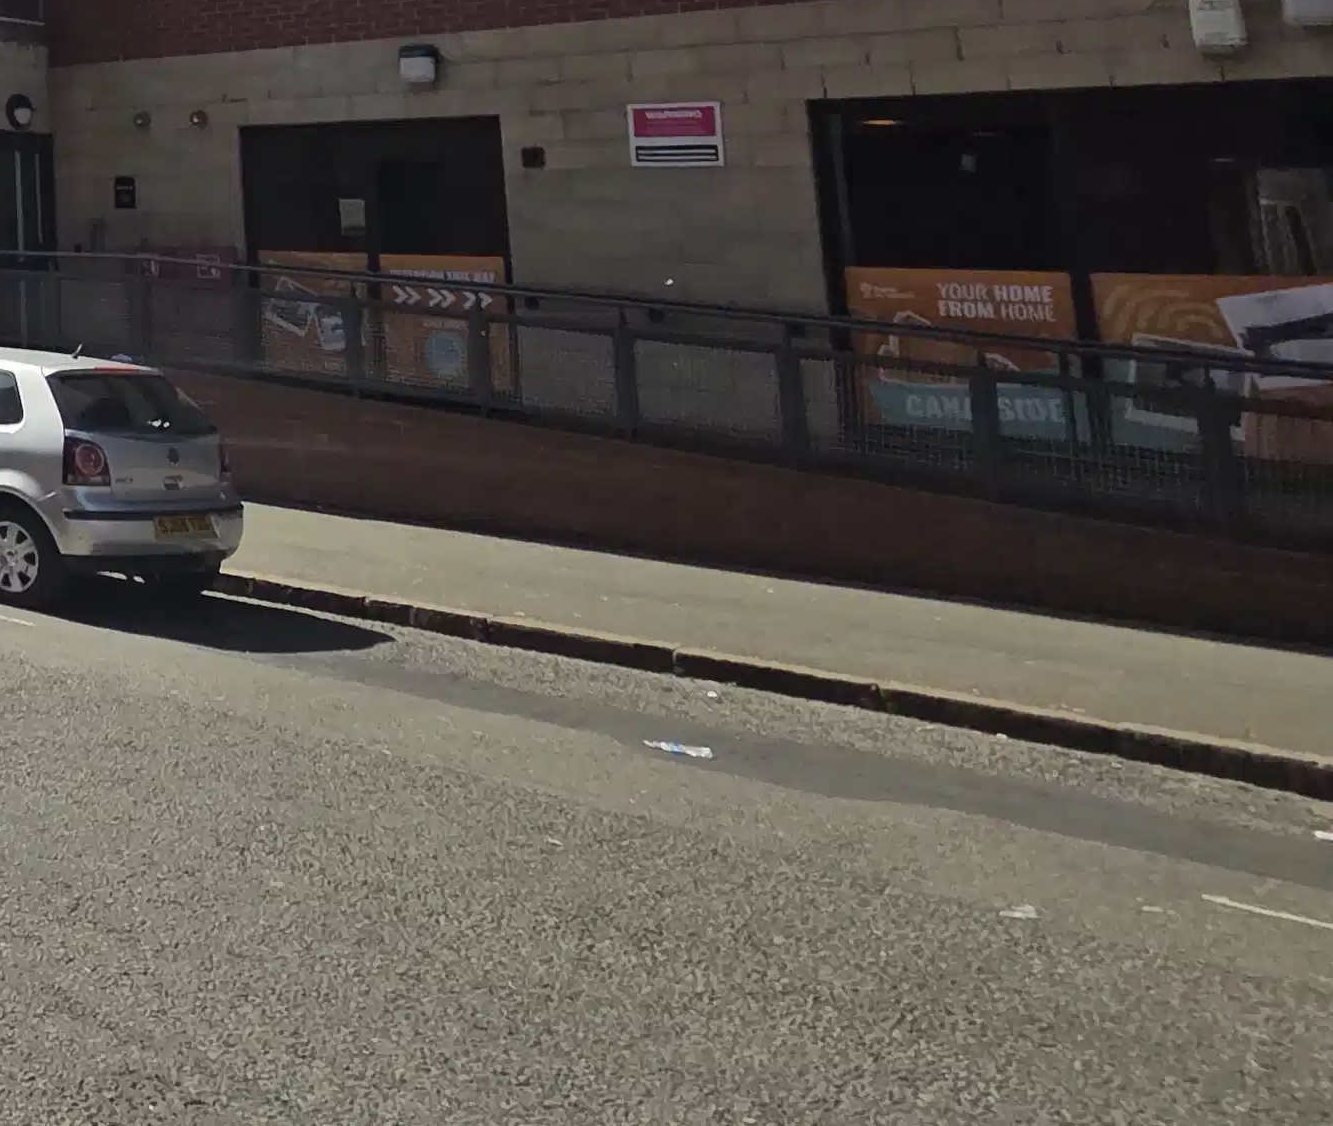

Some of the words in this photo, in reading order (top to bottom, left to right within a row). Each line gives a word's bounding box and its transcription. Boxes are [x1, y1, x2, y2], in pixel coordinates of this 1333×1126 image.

[936, 282, 990, 300] YOUR
[993, 283, 1054, 302] HOME
[937, 299, 994, 319] FROM
[1000, 302, 1058, 323] HOME
